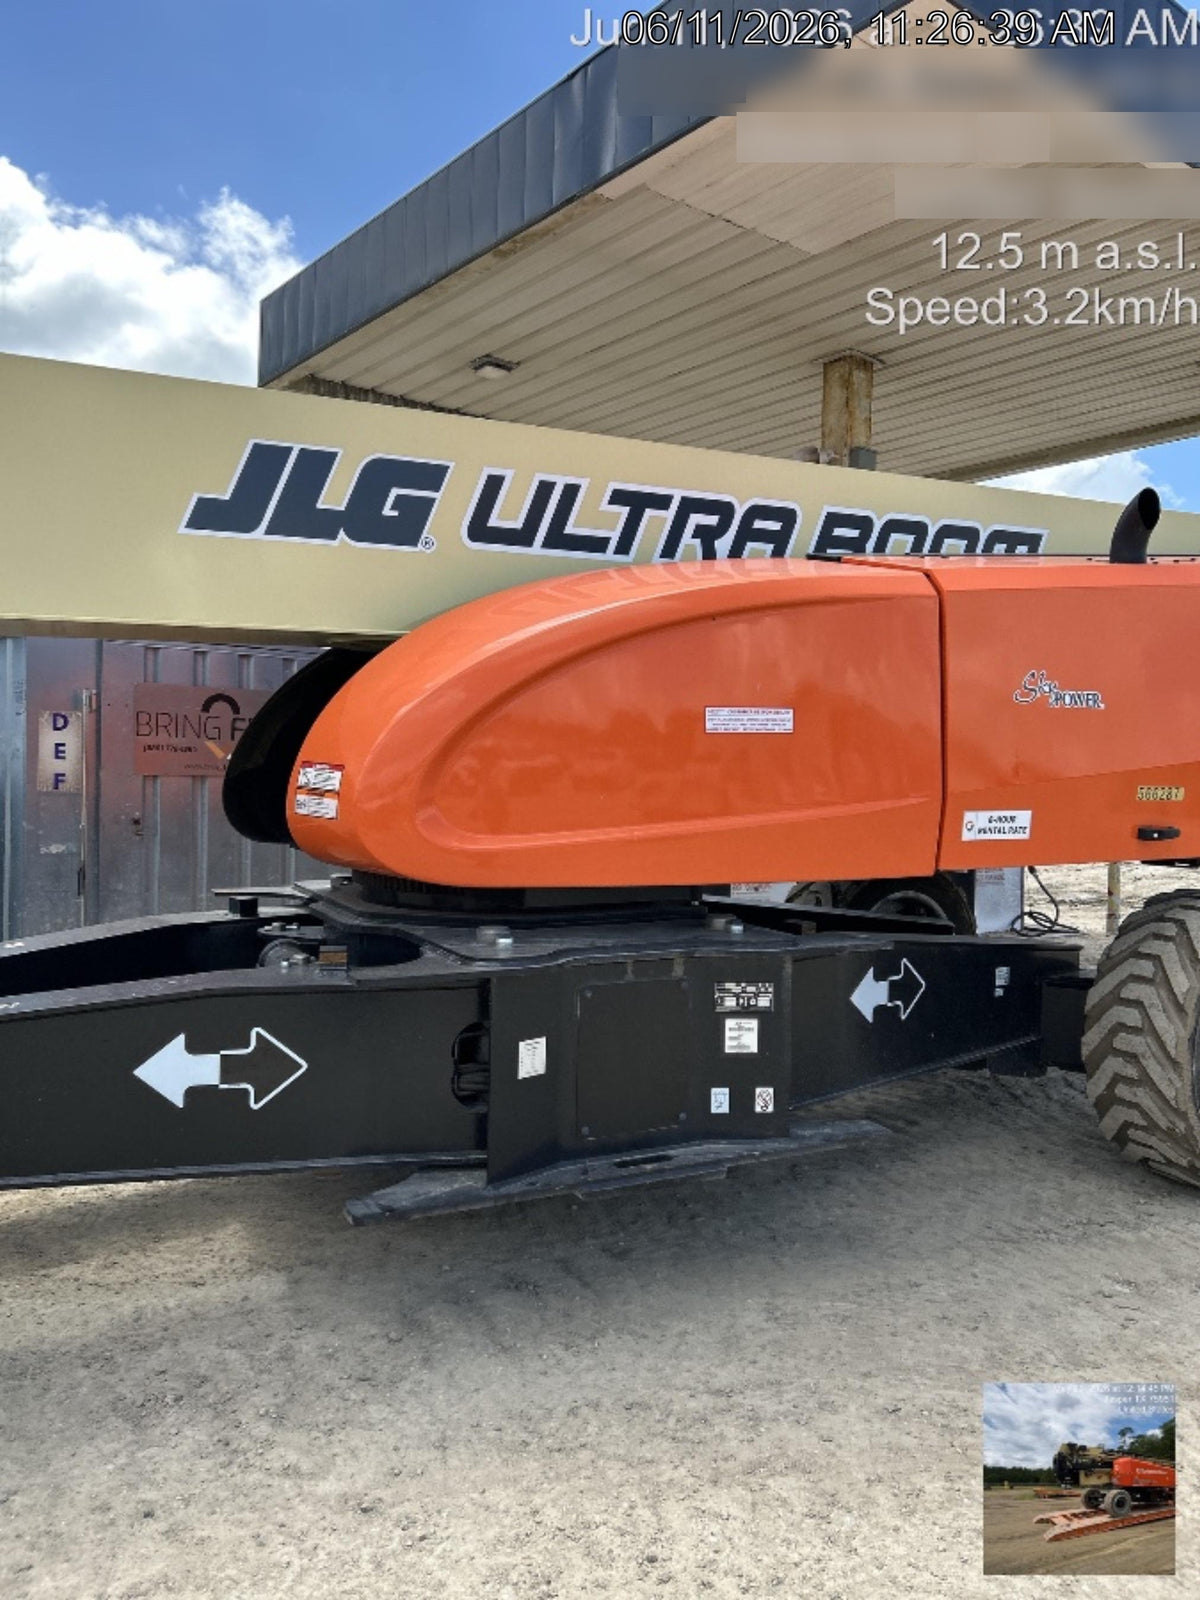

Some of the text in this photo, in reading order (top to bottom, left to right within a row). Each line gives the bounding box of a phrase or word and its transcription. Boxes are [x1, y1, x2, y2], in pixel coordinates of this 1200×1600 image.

[177, 438, 455, 552] JLG
[461, 467, 802, 563] ULTRA
[135, 710, 221, 741] BRING
